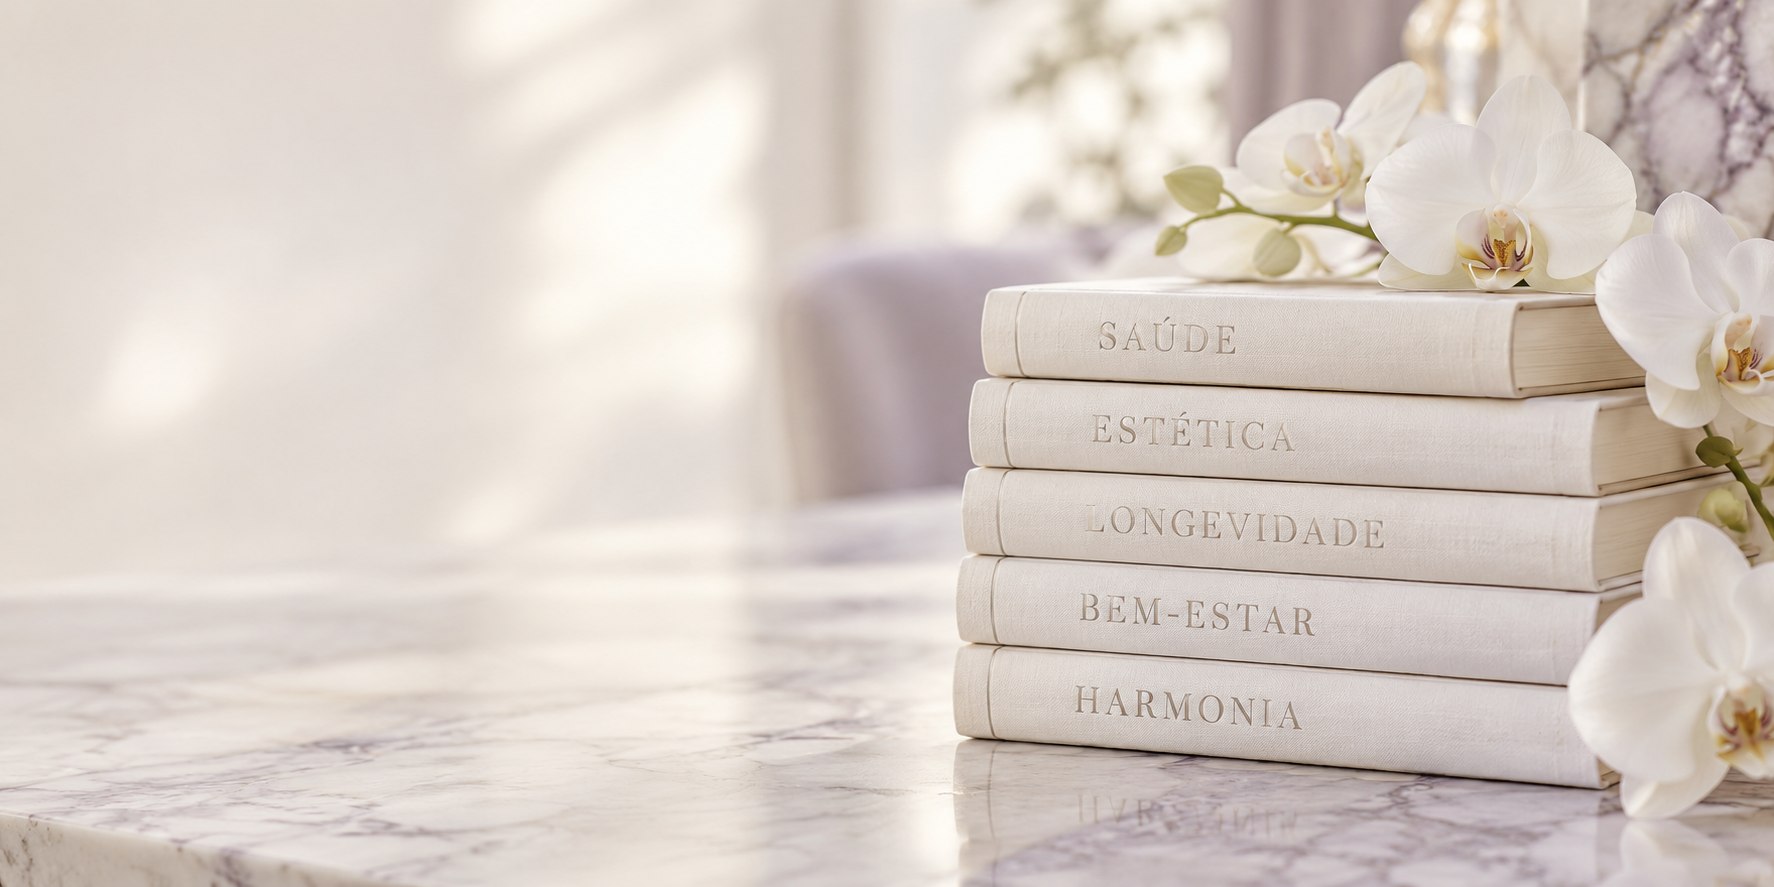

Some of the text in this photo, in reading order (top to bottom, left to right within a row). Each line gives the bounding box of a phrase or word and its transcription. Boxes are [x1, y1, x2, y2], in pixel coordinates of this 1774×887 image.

[1099, 316, 1237, 355] SAÚDE
[1092, 412, 1296, 452] ESTÉTICA
[1084, 504, 1385, 549] LONGEVIDADE
[1079, 593, 1316, 637] BEM-ESTAR
[1074, 685, 1303, 730] HARMONIA
